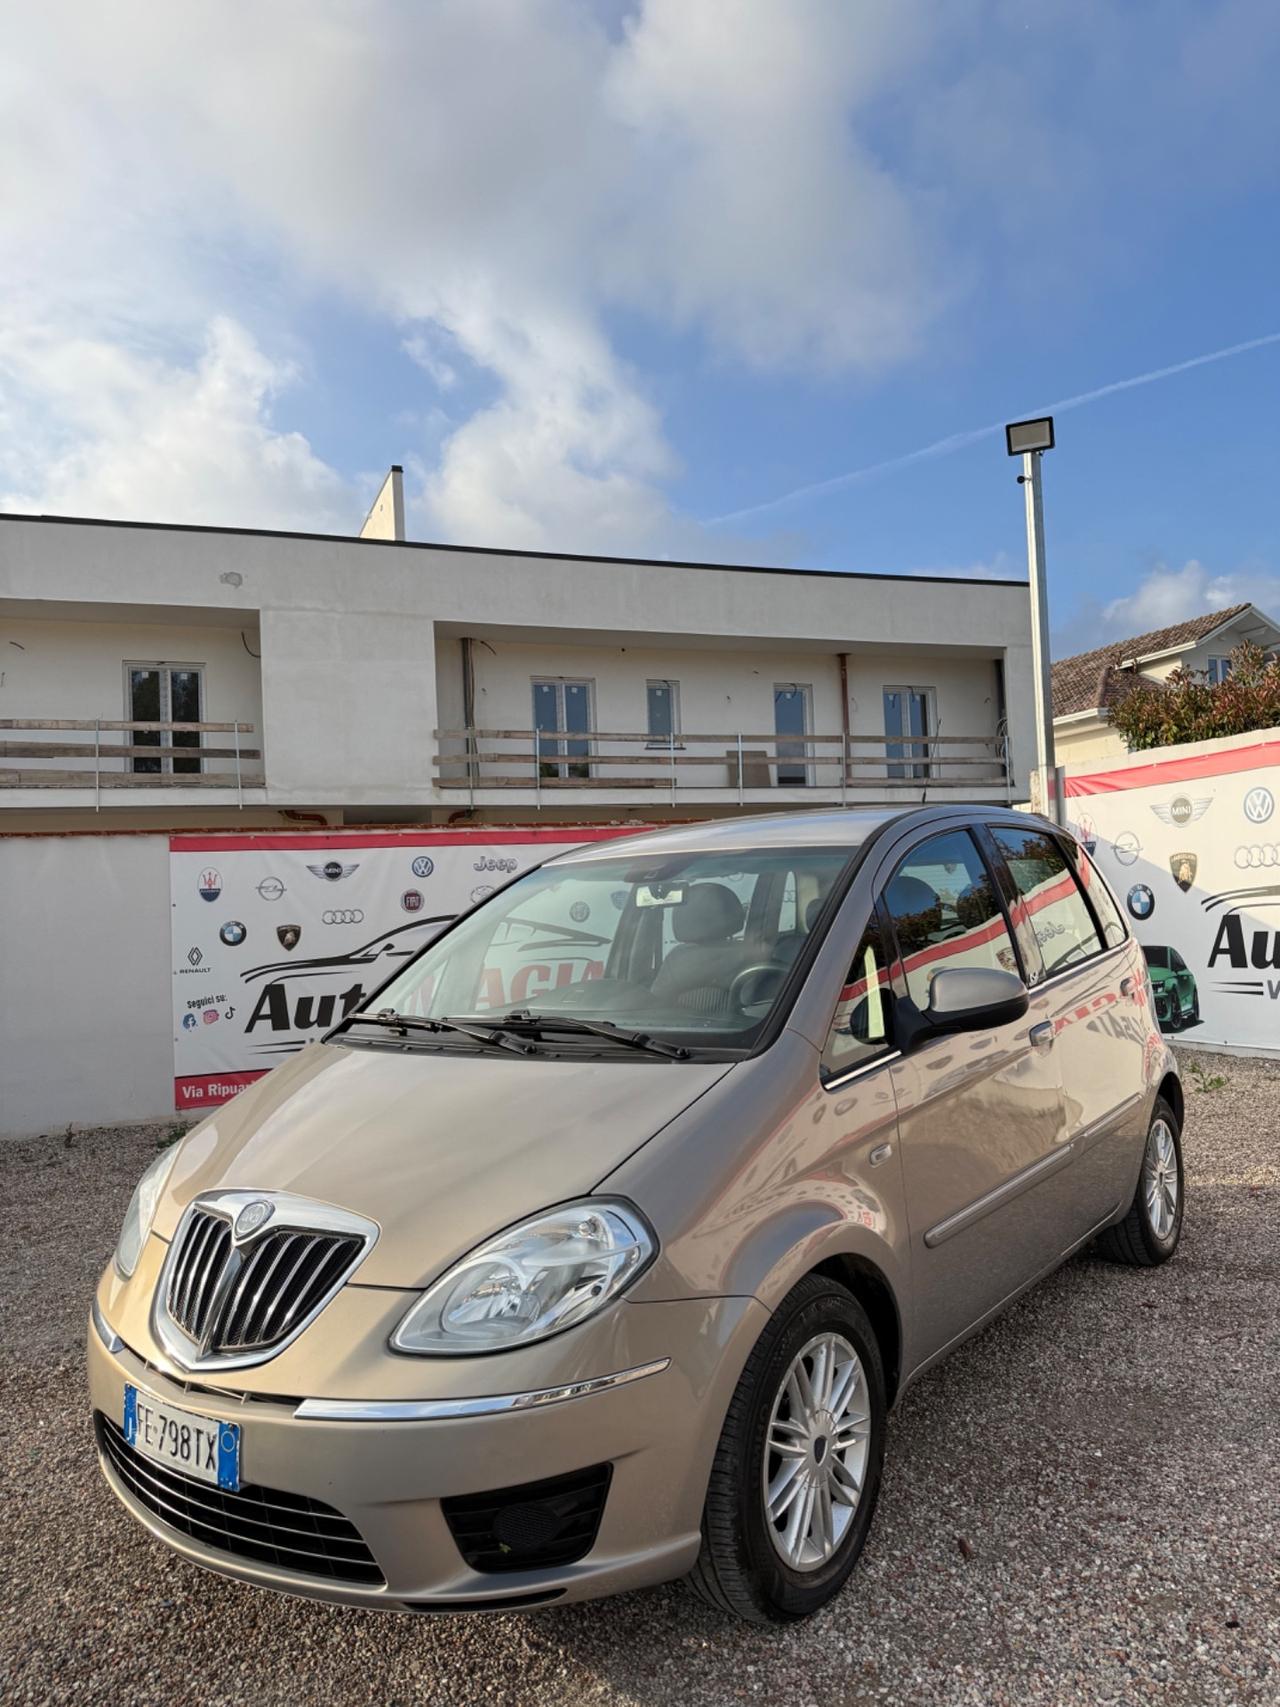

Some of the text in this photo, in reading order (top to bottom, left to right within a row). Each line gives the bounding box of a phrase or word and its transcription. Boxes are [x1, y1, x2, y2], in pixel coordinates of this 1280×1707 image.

[473, 856, 517, 873] Jeep
[1207, 914, 1280, 969] Au
[182, 1086, 203, 1098] Via
